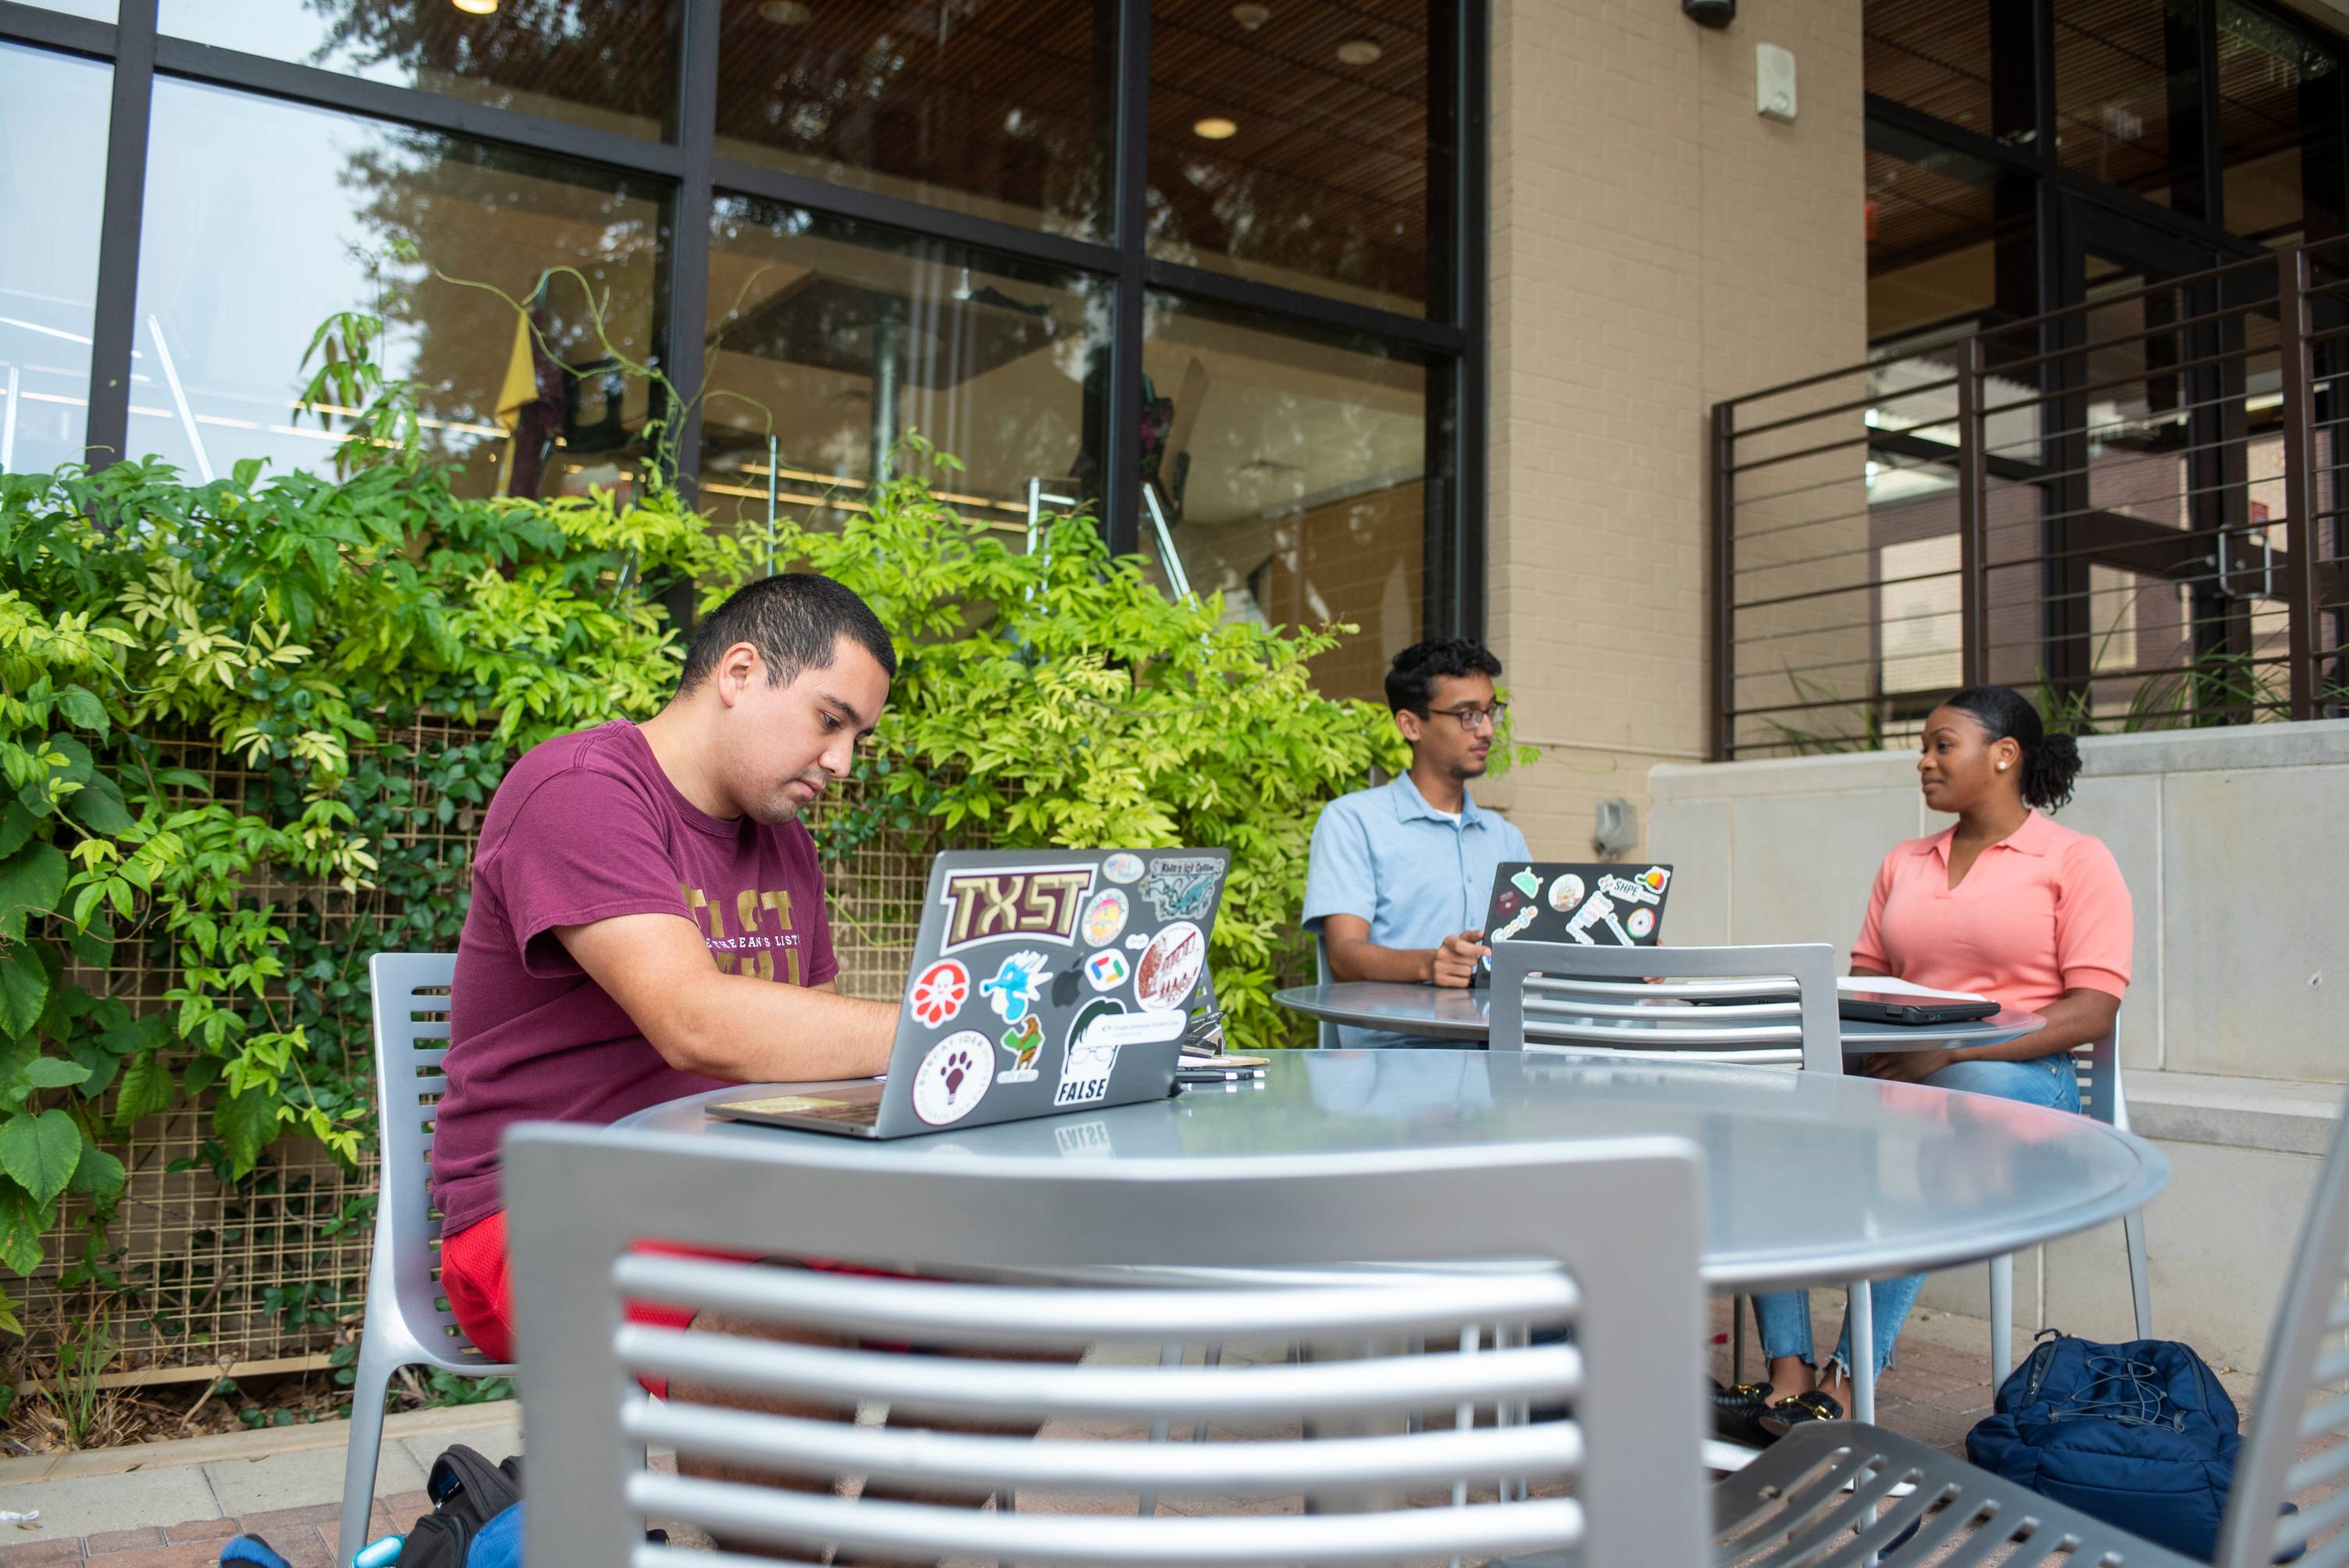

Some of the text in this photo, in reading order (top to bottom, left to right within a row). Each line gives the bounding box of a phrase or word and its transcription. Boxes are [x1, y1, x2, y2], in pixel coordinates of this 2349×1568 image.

[1614, 880, 1639, 896] SHPE
[950, 872, 1090, 943] TXST
[1058, 1078, 1106, 1102] FALSE
